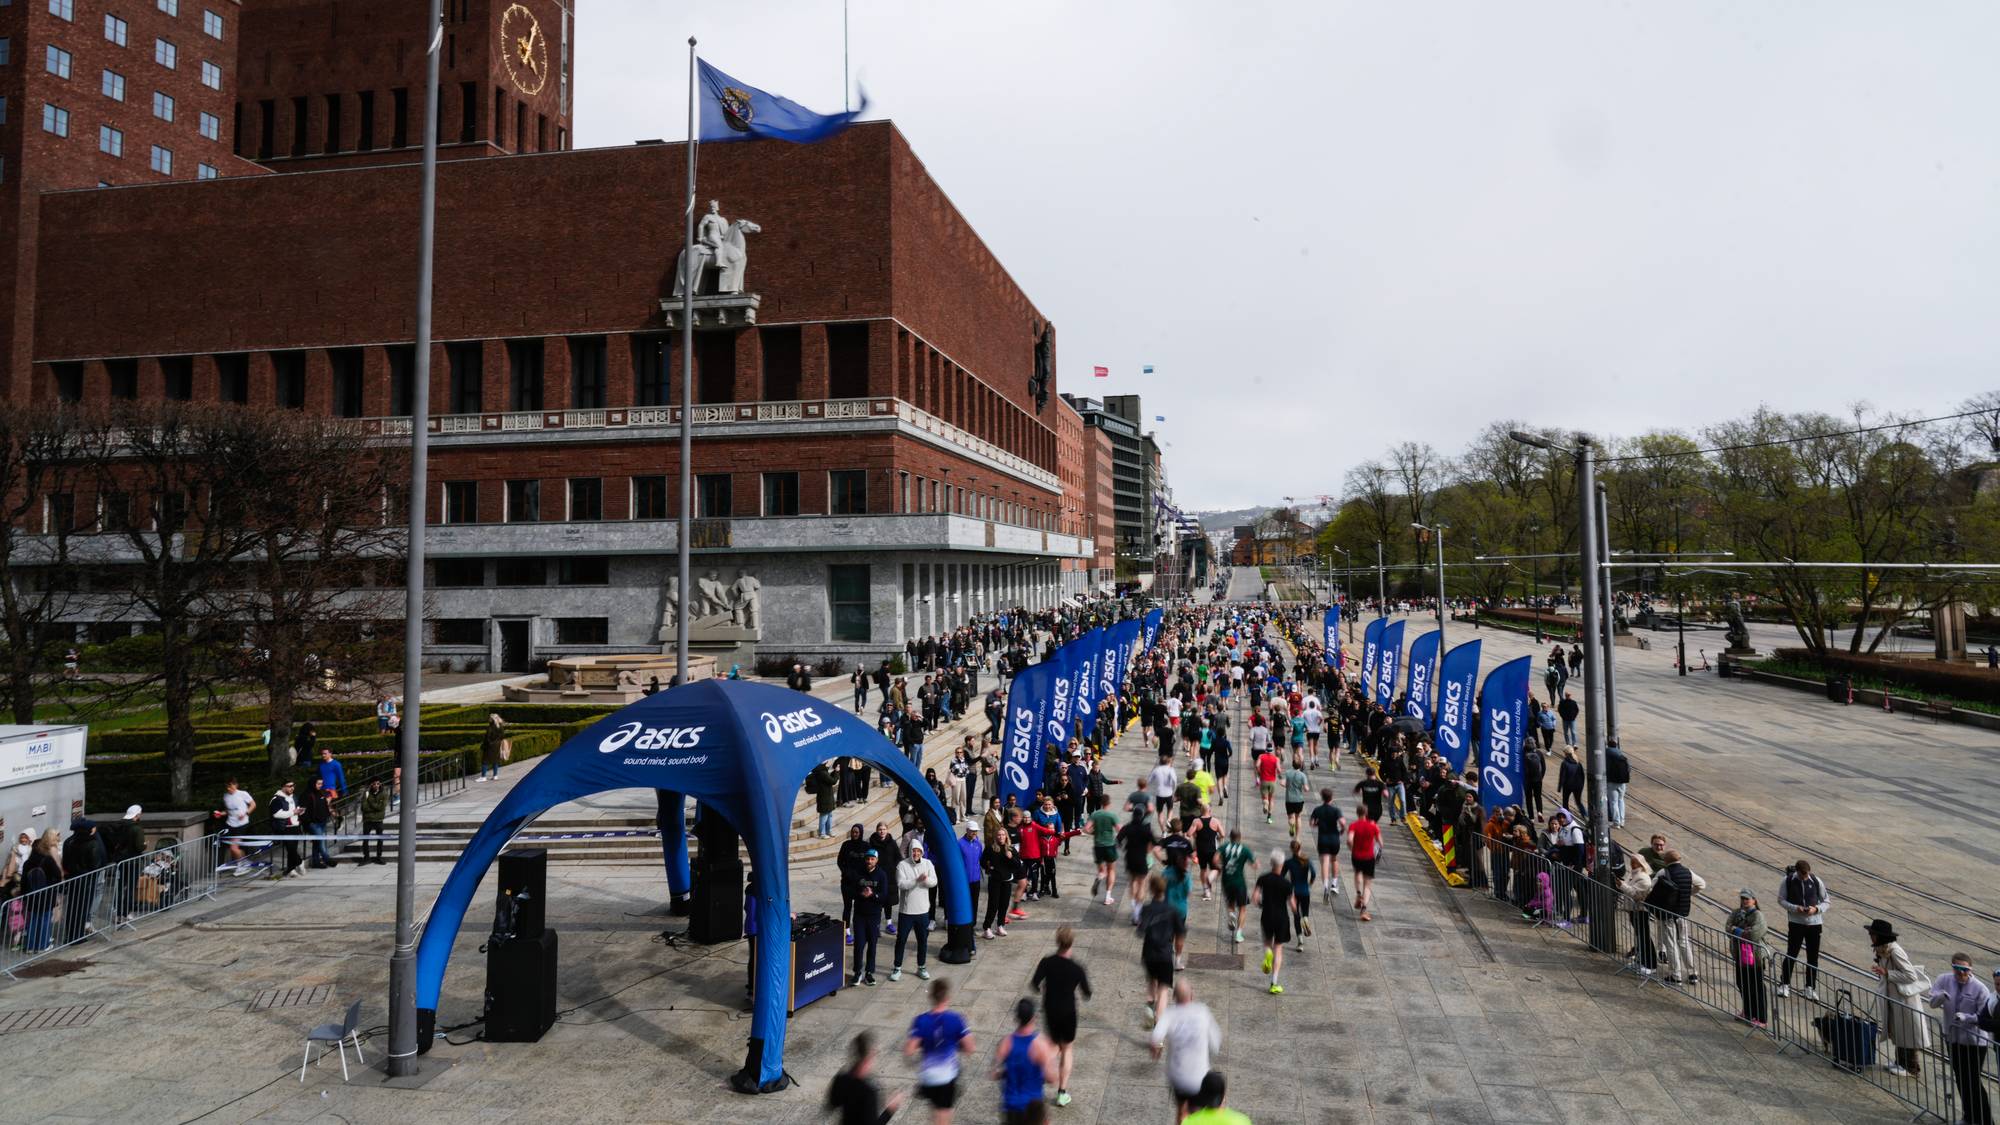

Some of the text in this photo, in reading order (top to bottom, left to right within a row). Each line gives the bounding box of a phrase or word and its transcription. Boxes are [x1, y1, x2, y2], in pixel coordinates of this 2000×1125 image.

[1104, 649, 1116, 681] asics
[1365, 642, 1376, 672] asics
[1382, 650, 1393, 683] asics
[1411, 663, 1426, 702] asics
[1052, 677, 1069, 722] asics
[1444, 680, 1462, 727] asics
[780, 706, 823, 734] asics
[1012, 706, 1034, 764] asics
[29, 743, 52, 755] MABI
[634, 725, 706, 750] asics
[1490, 708, 1511, 768] asics
[623, 754, 708, 766] sound mind, sound body
